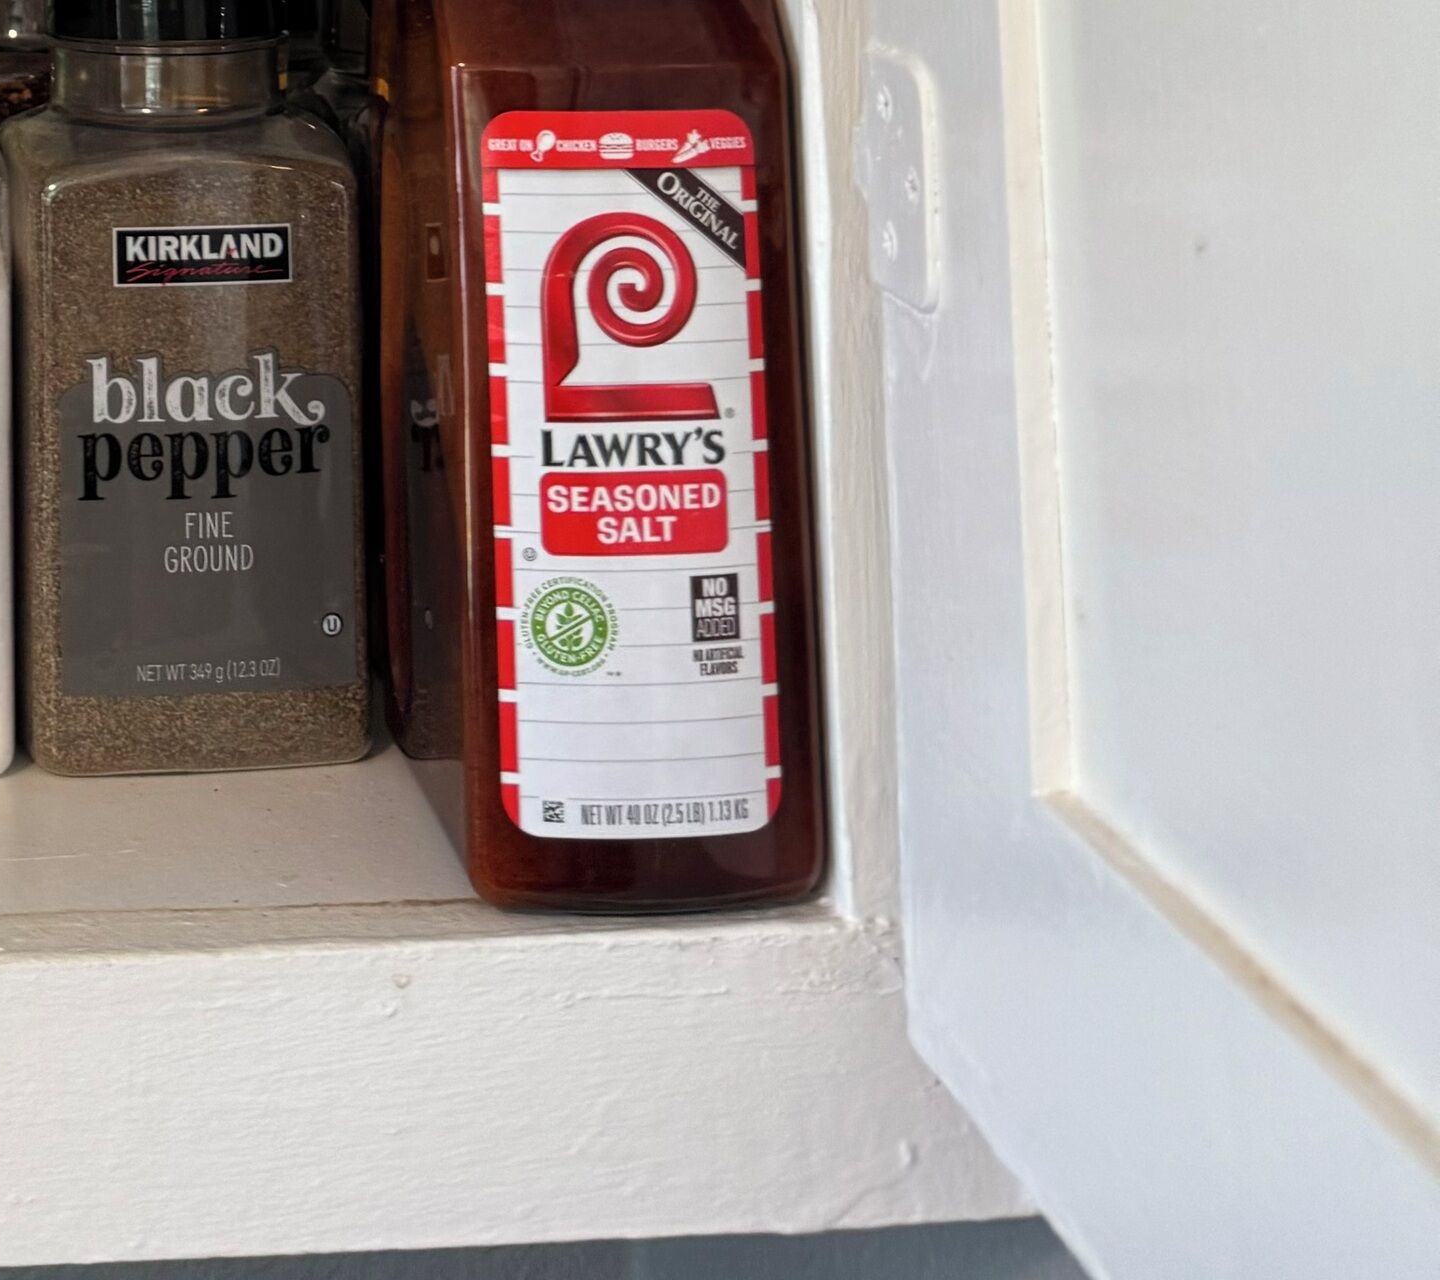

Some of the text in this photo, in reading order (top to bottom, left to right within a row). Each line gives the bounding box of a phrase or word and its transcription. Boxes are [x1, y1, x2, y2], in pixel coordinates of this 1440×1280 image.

[656, 171, 739, 250] ORIGINAL
[695, 186, 721, 214] THE
[124, 232, 285, 262] KIRKLAND
[124, 261, 285, 287] Signature
[85, 352, 327, 427] black
[76, 423, 331, 501] pepper
[540, 427, 727, 468] LAWRY'S
[546, 482, 722, 513] SEASONED
[184, 511, 235, 540] FINE
[596, 515, 678, 545] SALT
[163, 543, 255, 574] GROUND
[701, 577, 729, 598] NO
[534, 589, 570, 622] BEYOND
[693, 597, 737, 618] MSG
[695, 617, 737, 639] ADDED
[136, 663, 163, 683] NET
[164, 663, 188, 681] WT
[189, 662, 213, 681] 349
[259, 657, 282, 678] OZ)
[580, 797, 749, 827] NET WT 40 OZ (2.5 LB) 1.13 KG
